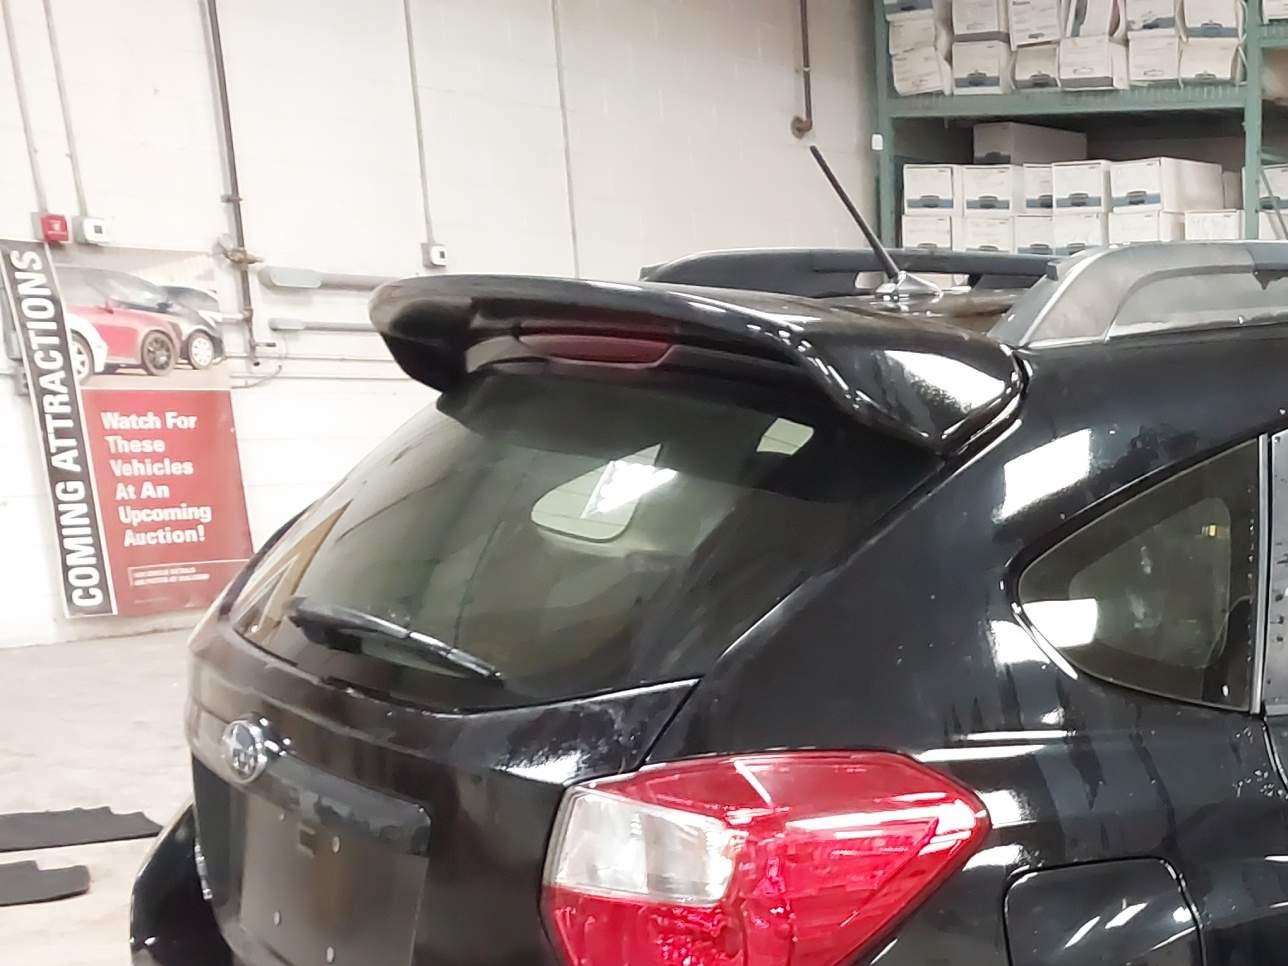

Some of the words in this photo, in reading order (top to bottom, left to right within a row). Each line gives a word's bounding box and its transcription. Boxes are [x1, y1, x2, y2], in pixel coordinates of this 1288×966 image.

[10, 250, 82, 472] ATTRACTIONS
[100, 411, 162, 430] Watch
[164, 411, 198, 429] For
[104, 435, 165, 454] These
[109, 457, 194, 476] Vehicles
[115, 482, 137, 500] At
[140, 480, 170, 499] An
[118, 502, 212, 527] Upcoming
[55, 481, 103, 607] COMING
[123, 524, 205, 547] Auction!
